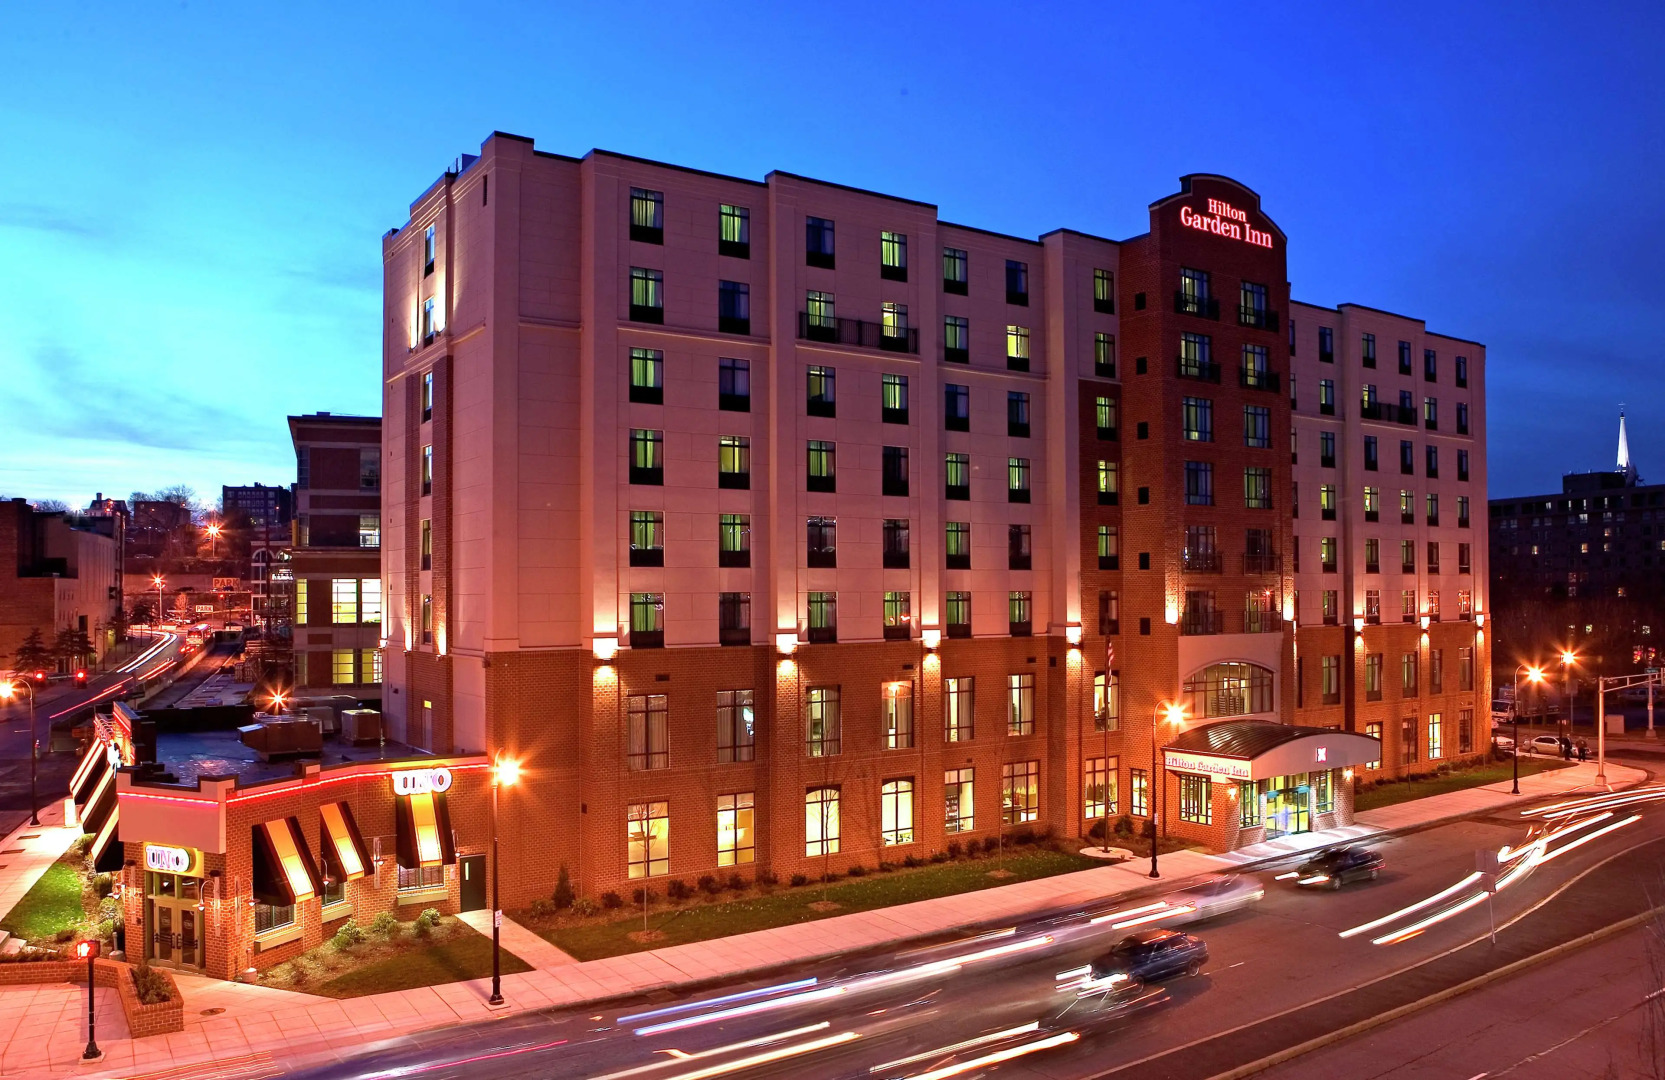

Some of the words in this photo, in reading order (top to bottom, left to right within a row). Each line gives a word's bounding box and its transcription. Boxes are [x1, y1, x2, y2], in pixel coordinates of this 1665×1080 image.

[1208, 198, 1247, 222] Hilton
[1180, 206, 1241, 240] Garden
[1244, 223, 1273, 248] Inn
[214, 579, 240, 588] PARK
[1165, 756, 1195, 770] Hilton
[1197, 761, 1230, 775] Garden
[1232, 765, 1249, 777] Inn
[392, 768, 452, 795] UNO
[146, 846, 189, 872] UNO
